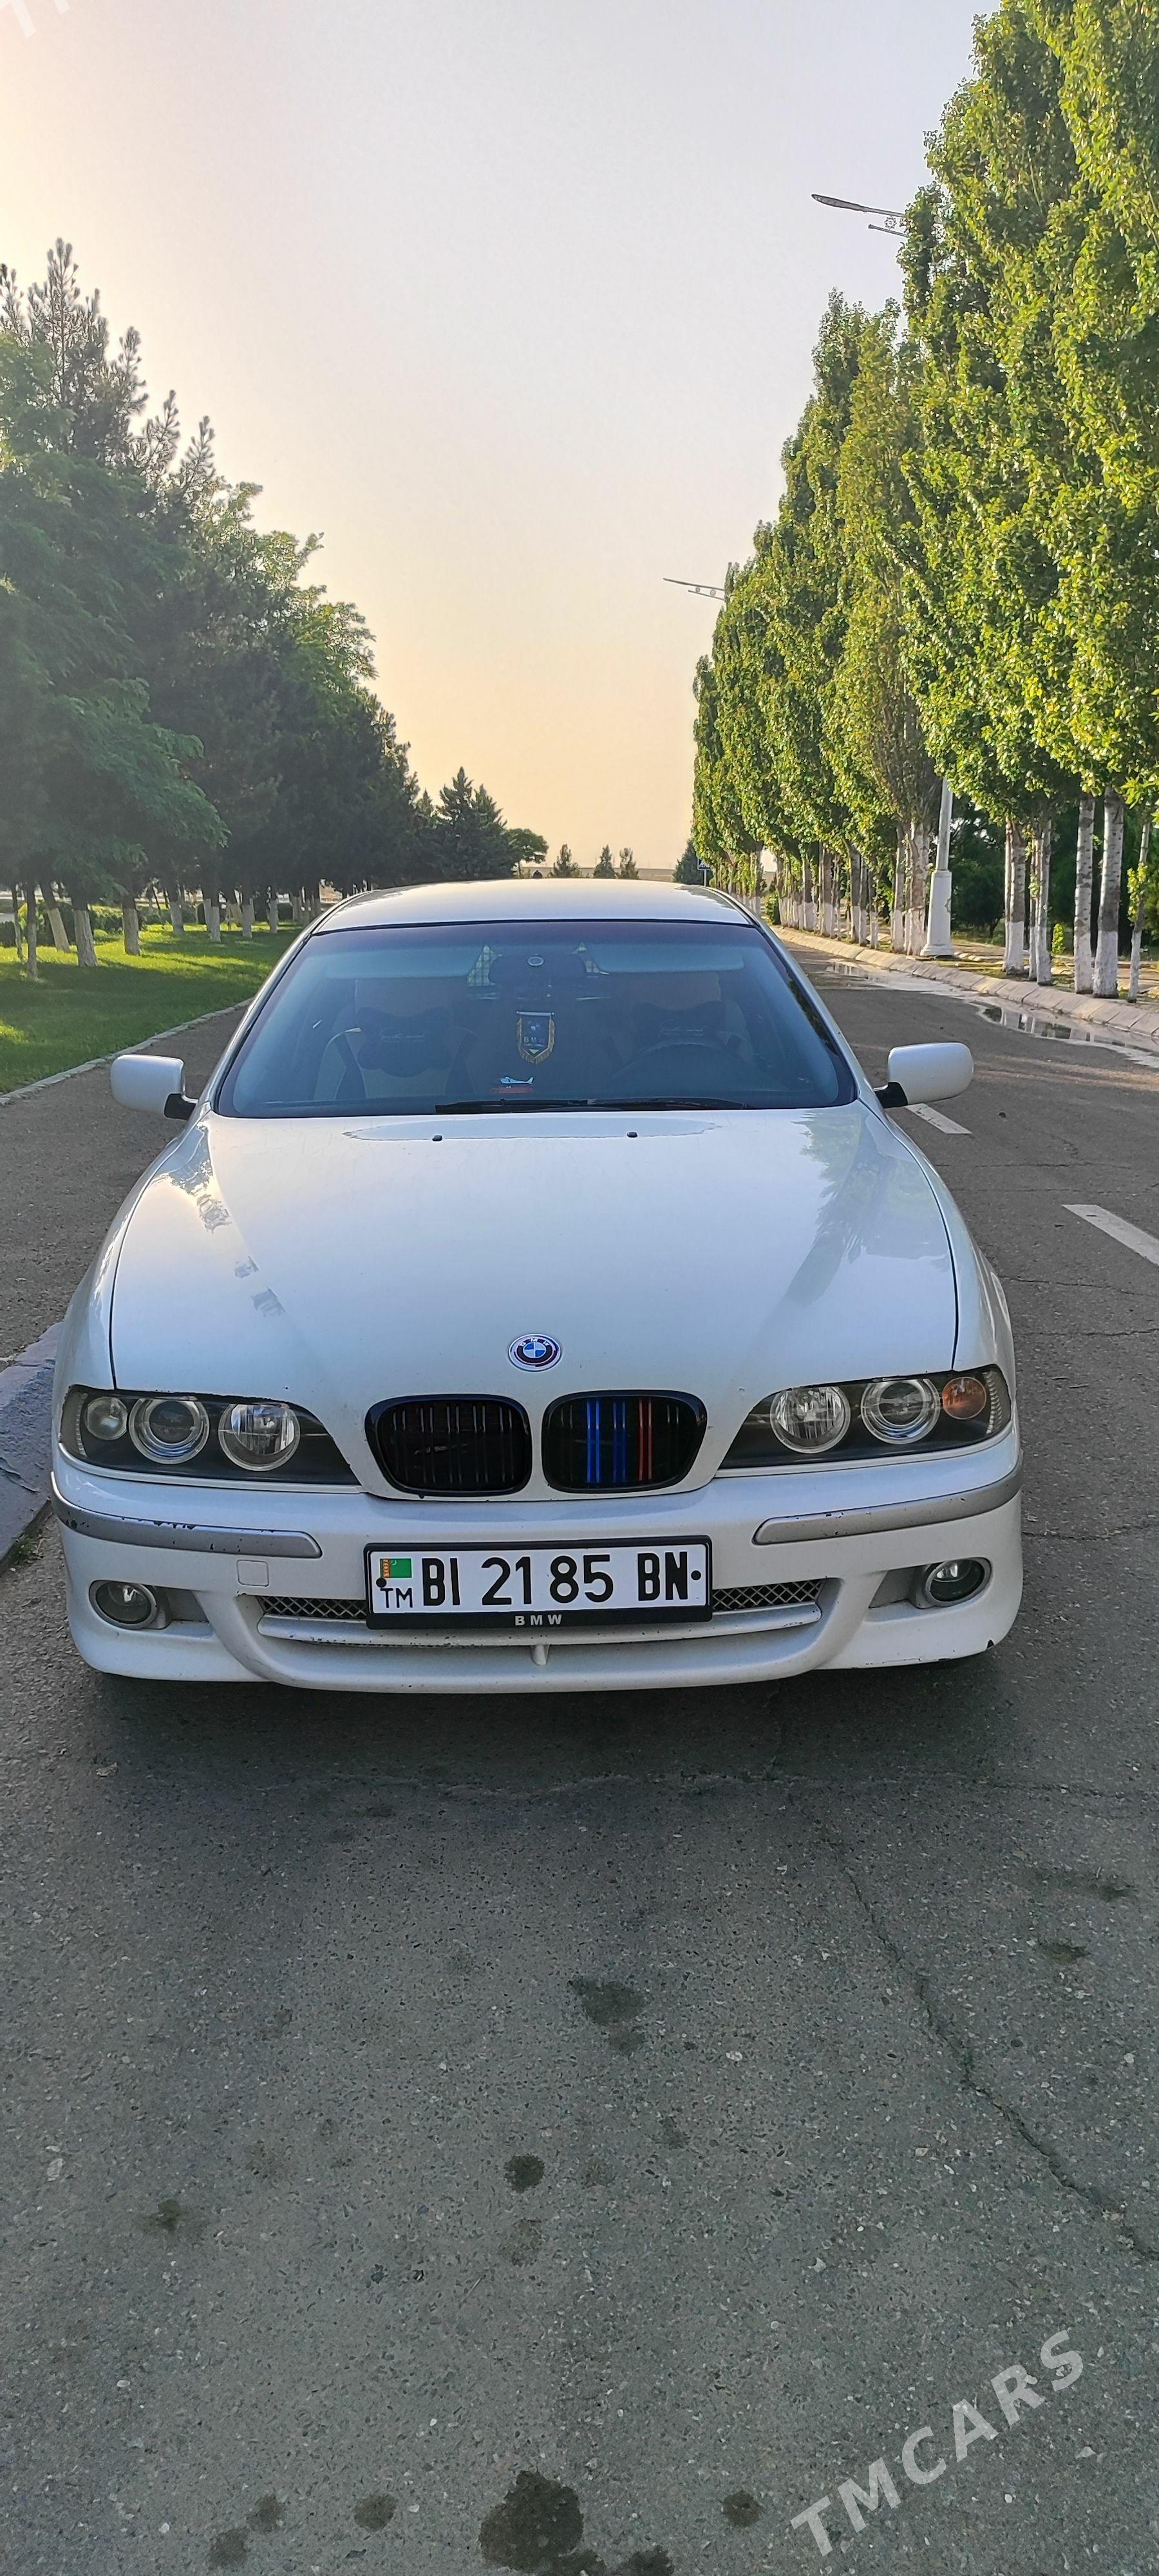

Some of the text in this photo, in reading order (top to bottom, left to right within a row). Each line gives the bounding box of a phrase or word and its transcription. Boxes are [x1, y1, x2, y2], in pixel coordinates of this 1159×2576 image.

[422, 1551, 688, 1606] BI 21 85 BN
[380, 1587, 413, 1608] TM
[515, 1614, 562, 1626] BMW
